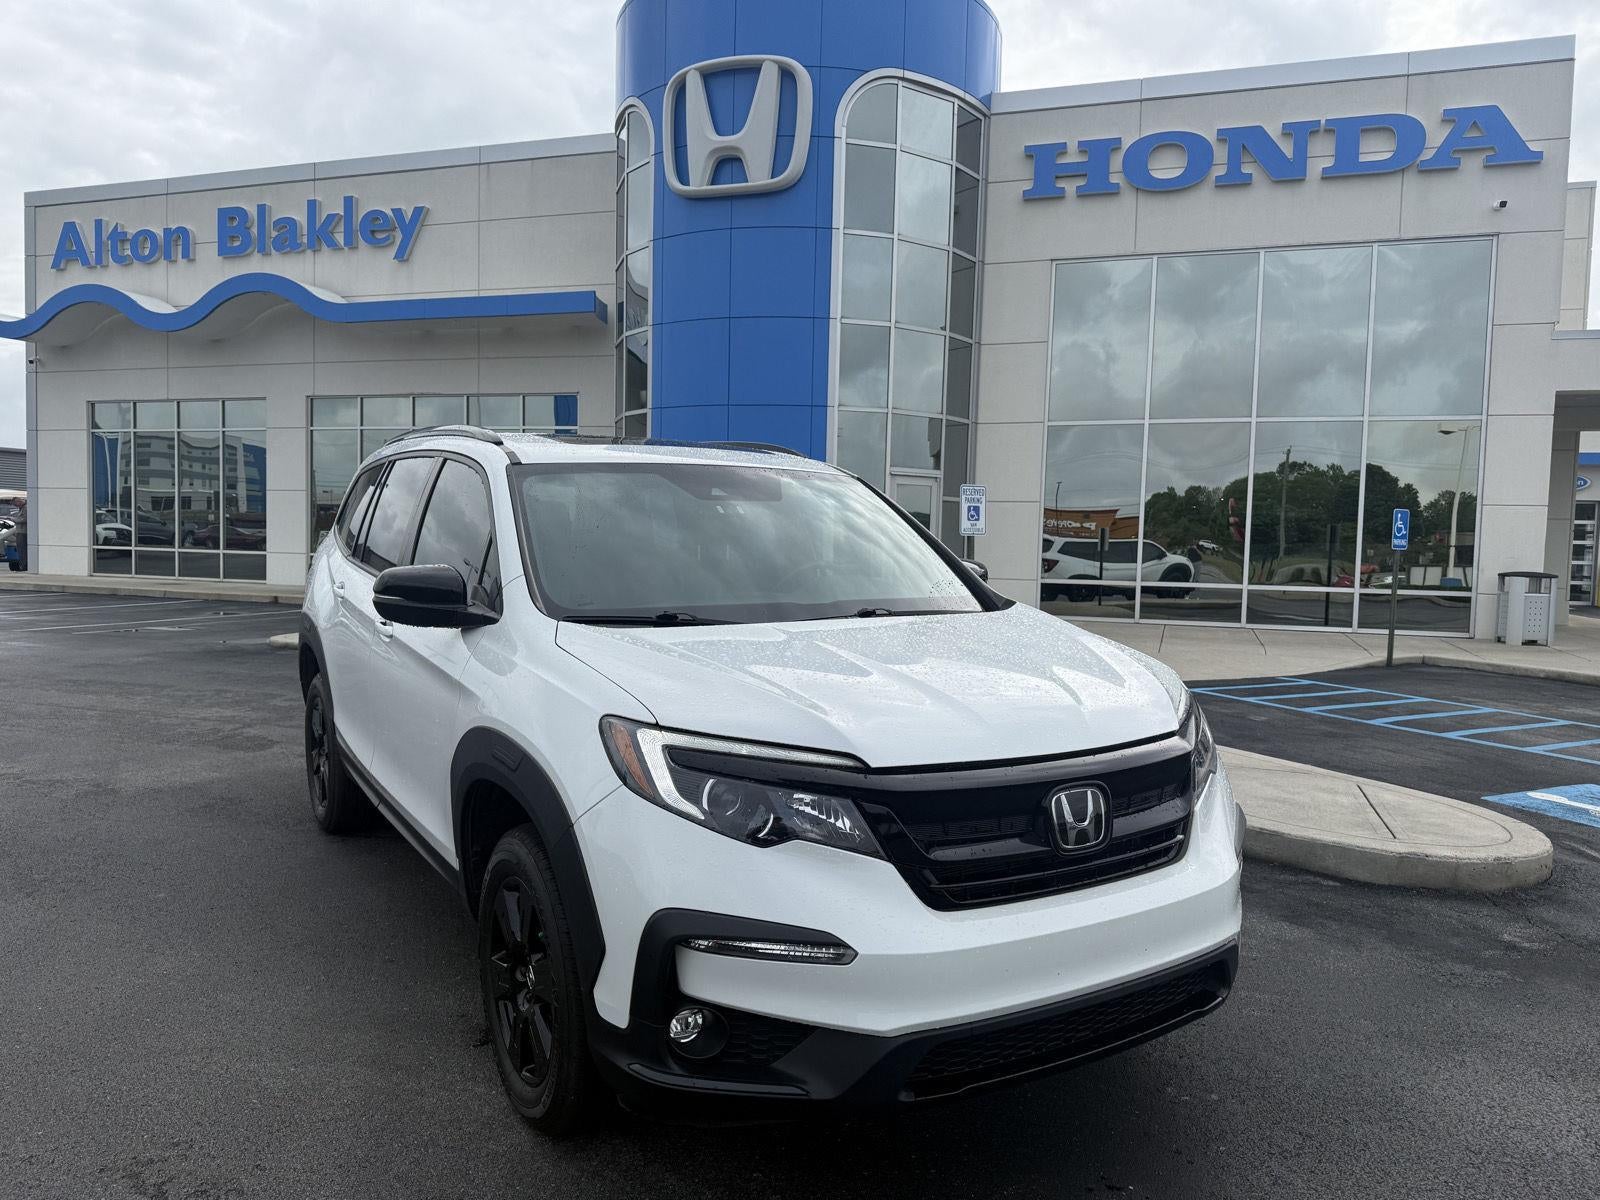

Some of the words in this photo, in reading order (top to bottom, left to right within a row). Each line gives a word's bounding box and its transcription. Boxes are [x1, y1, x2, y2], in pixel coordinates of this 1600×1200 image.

[1023, 104, 1544, 199] HONDA
[51, 217, 194, 270] Alton
[217, 195, 429, 263] Blakley
[963, 488, 984, 496] RESERVED
